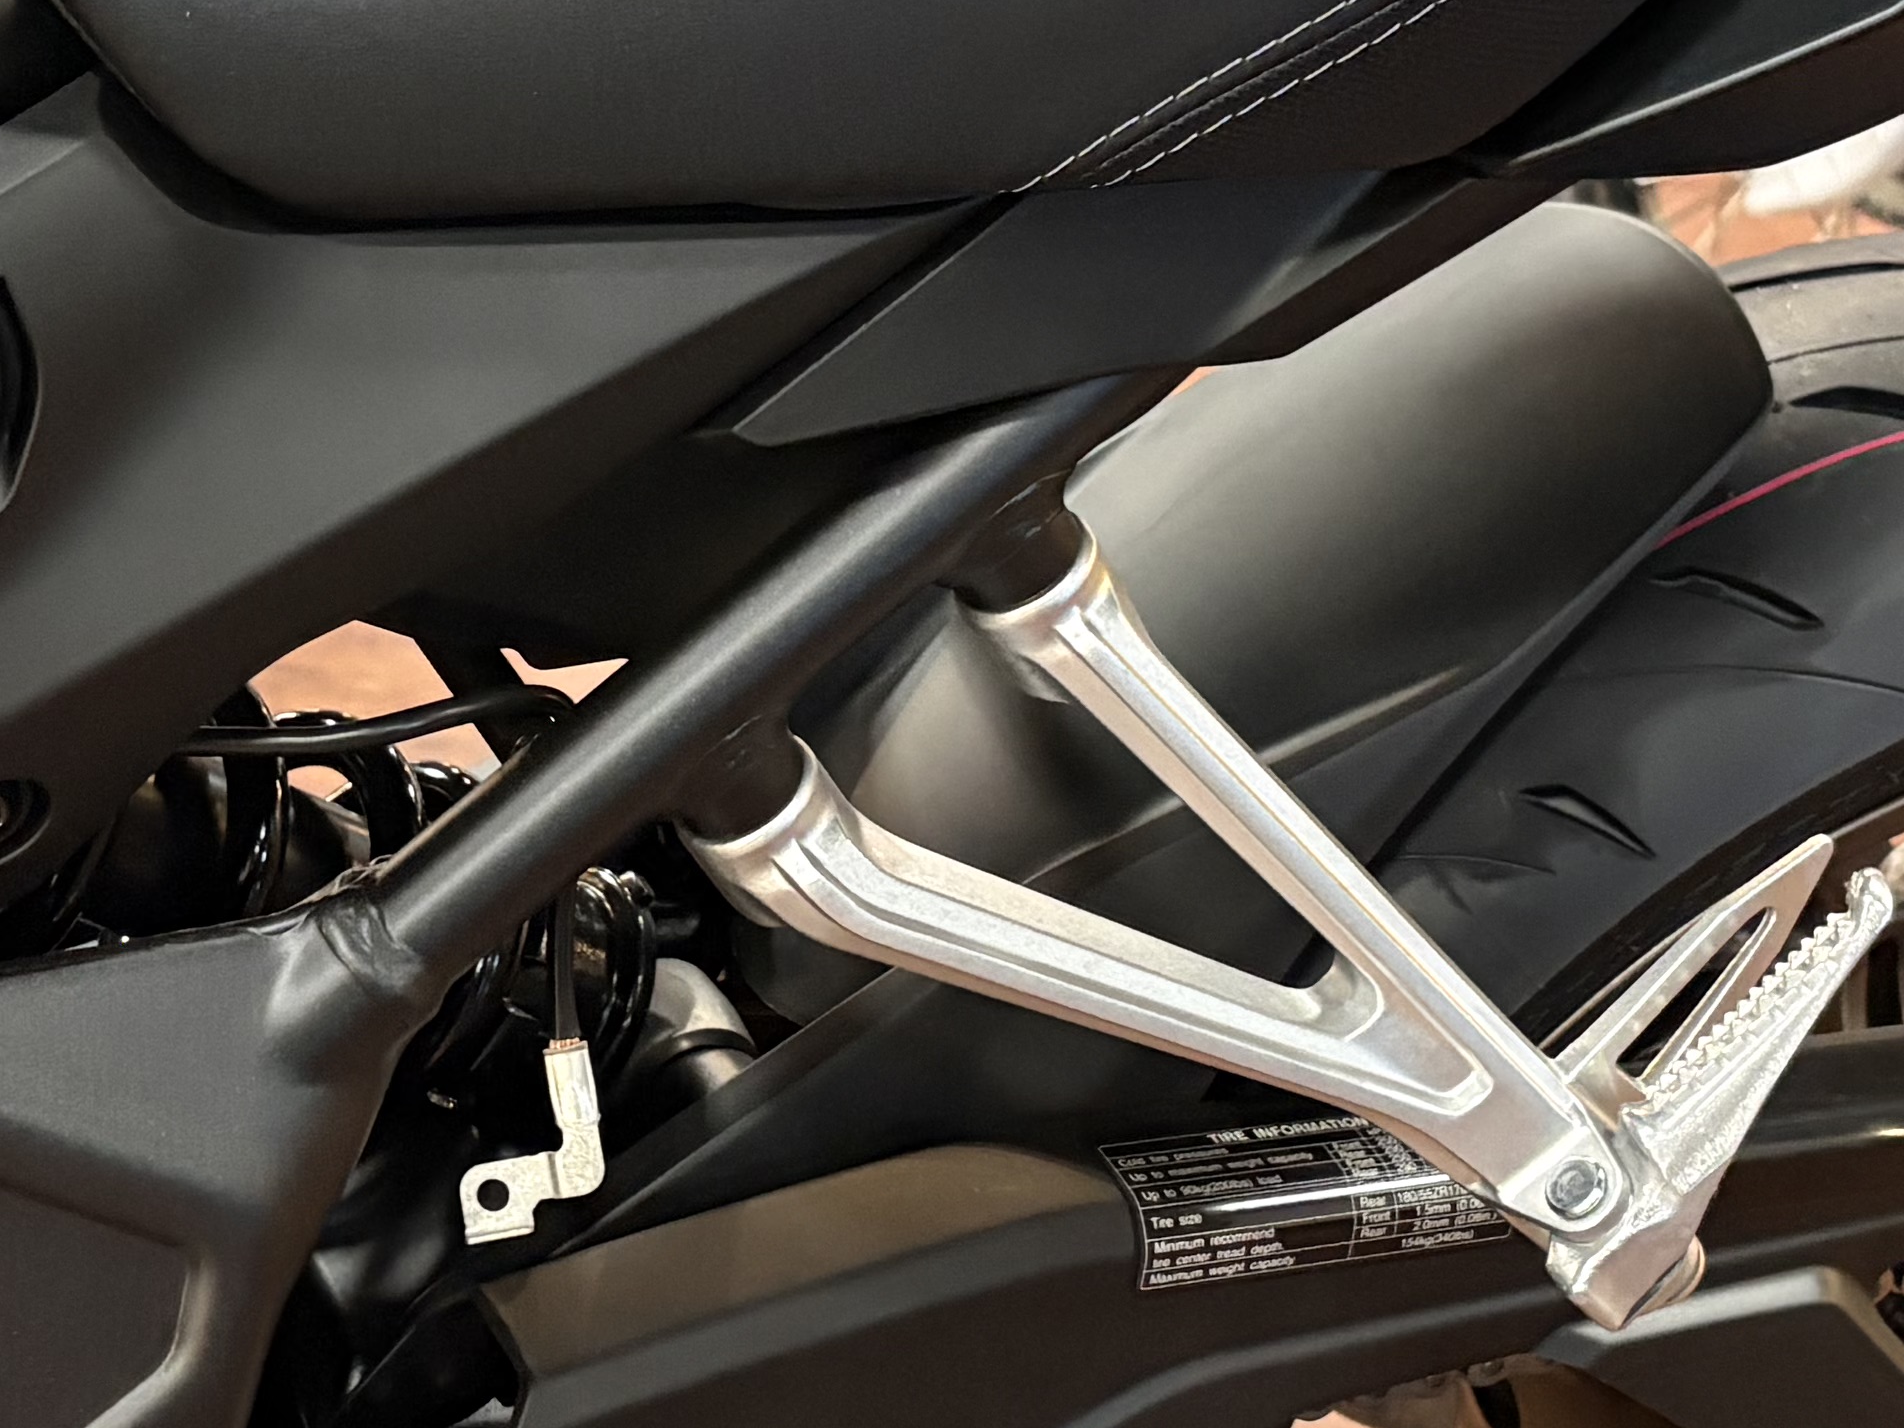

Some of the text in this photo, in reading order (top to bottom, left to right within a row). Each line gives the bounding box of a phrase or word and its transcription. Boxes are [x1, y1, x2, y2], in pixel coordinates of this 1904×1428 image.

[1206, 1130, 1250, 1144] TIRE
[1252, 1117, 1370, 1140] INFORMATION
[1140, 1190, 1161, 1203] Up
[1163, 1188, 1177, 1199] to
[1359, 1195, 1387, 1209] Rear
[1149, 1213, 1203, 1230] Tire size
[1362, 1210, 1392, 1224] Front
[1153, 1227, 1276, 1255] Minimum recommend
[1359, 1226, 1387, 1239] Rear
[1175, 1252, 1213, 1266] center
[1216, 1246, 1247, 1260] tread
[1149, 1255, 1296, 1285] Maximum weight capacity
